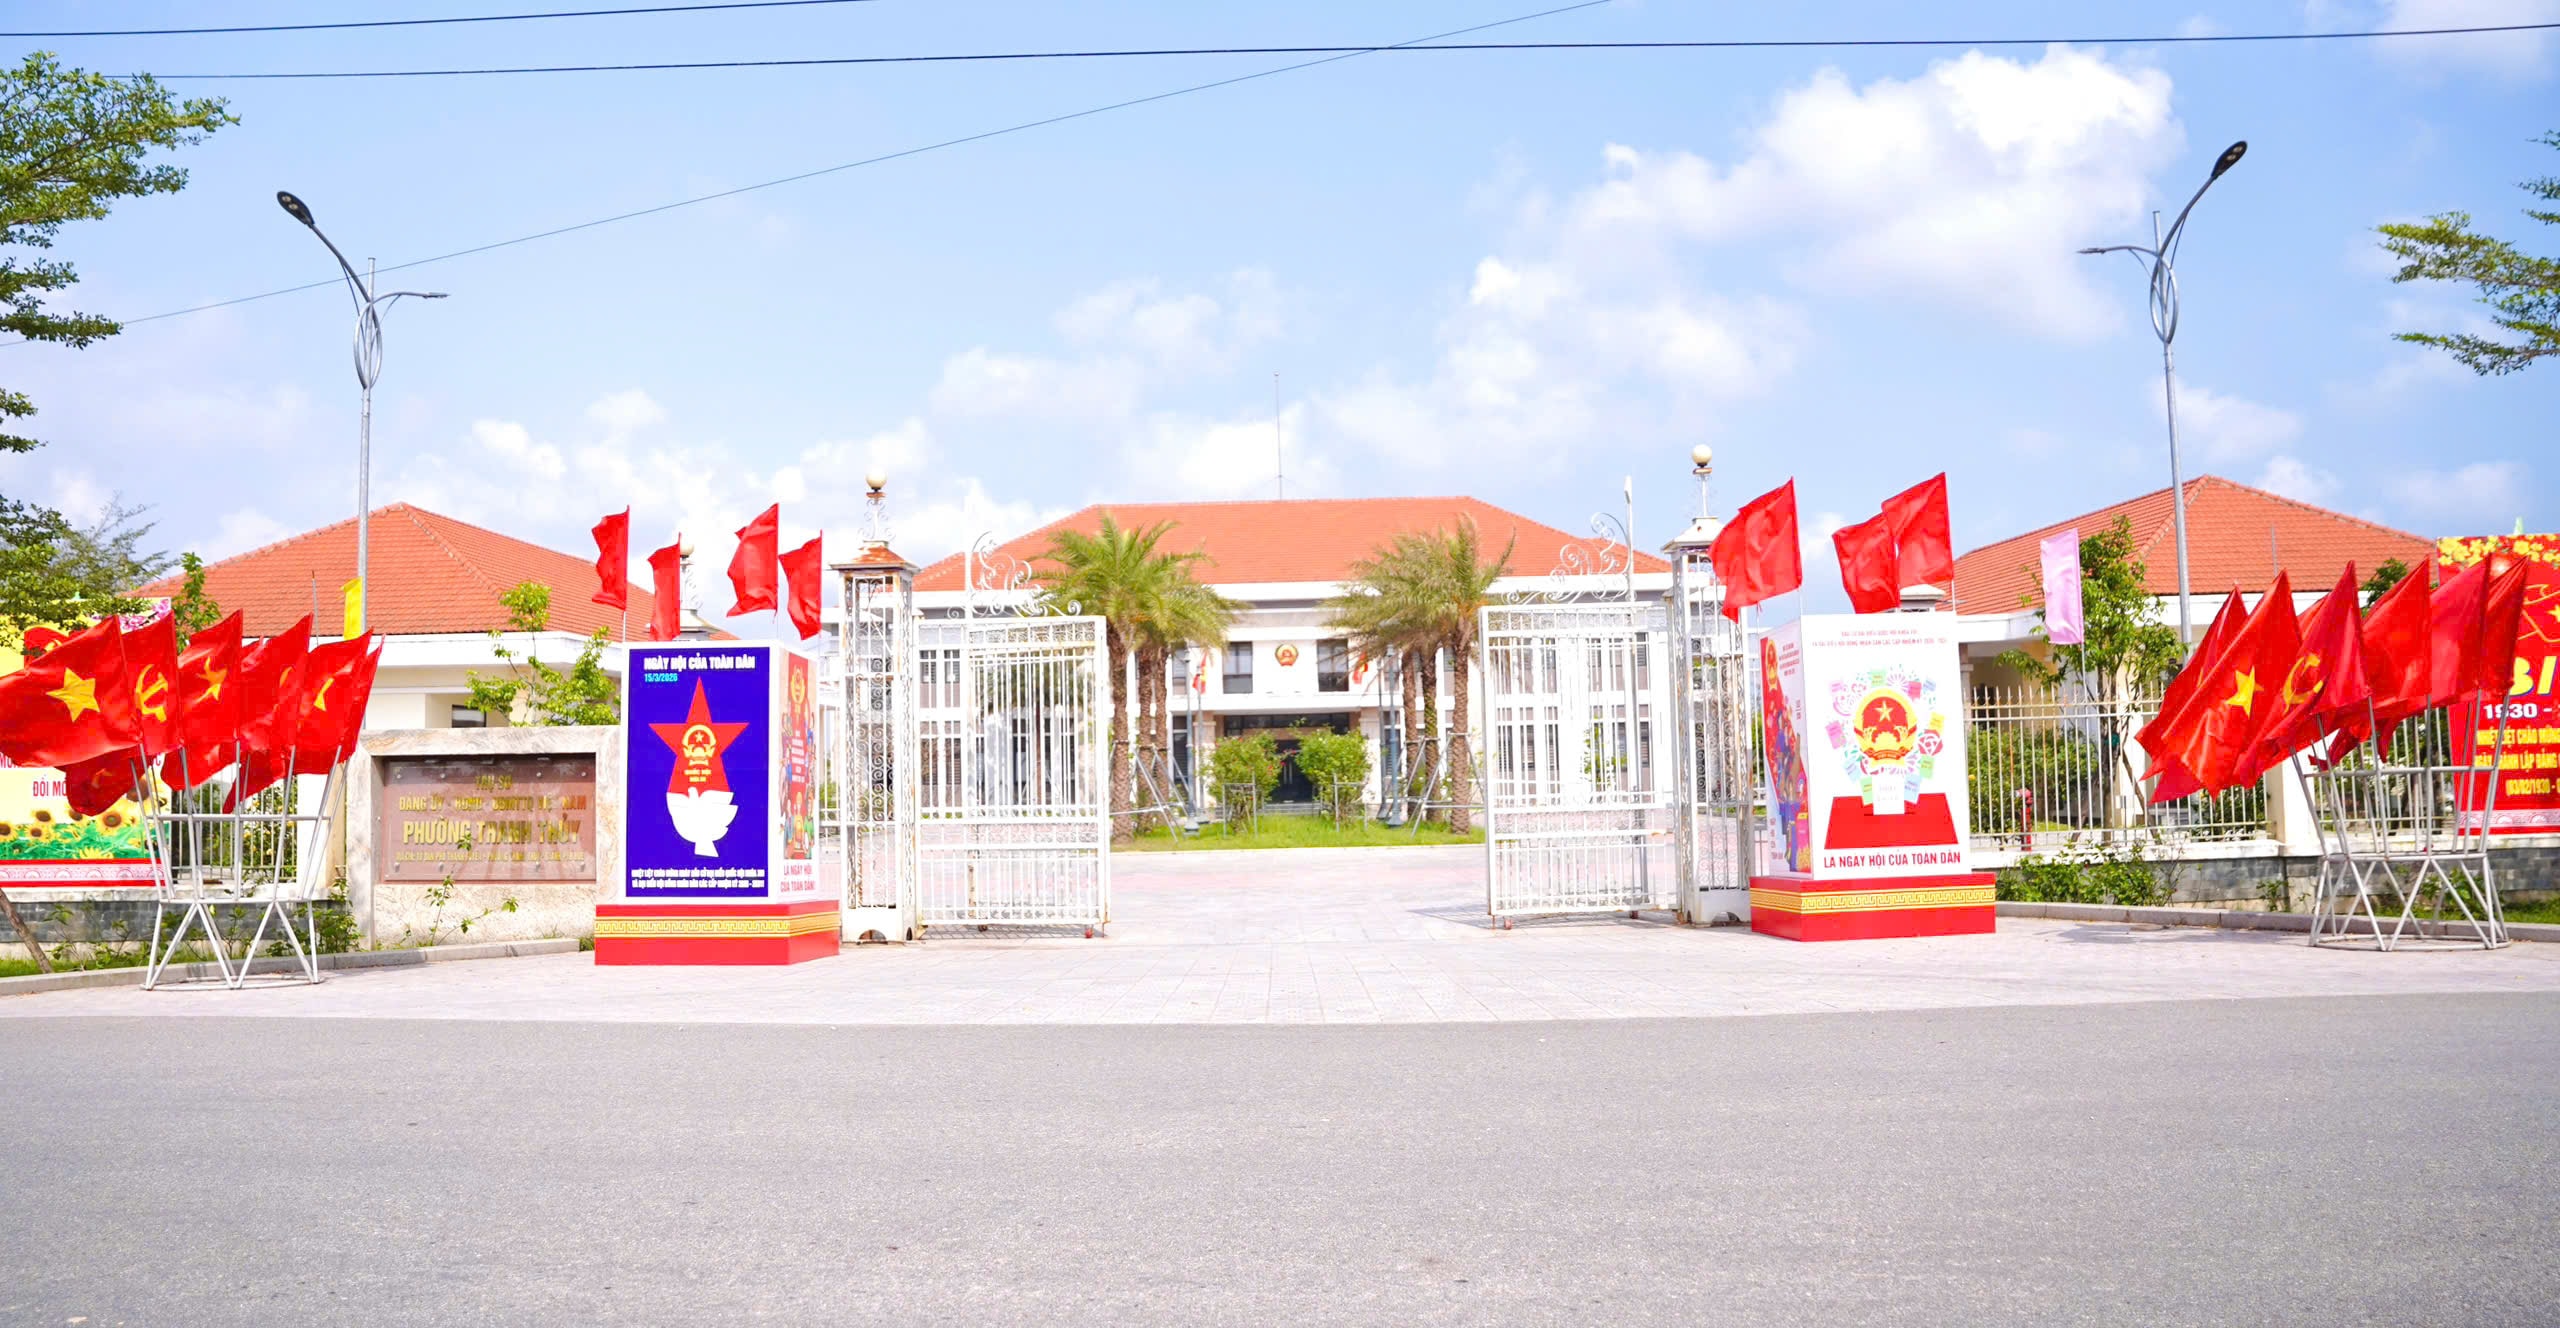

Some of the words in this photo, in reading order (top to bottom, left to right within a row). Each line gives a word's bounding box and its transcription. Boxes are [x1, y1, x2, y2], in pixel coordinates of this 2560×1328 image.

[644, 655, 669, 670] NGÀY
[670, 655, 687, 672] HỘI
[688, 652, 708, 670] CỦA
[709, 654, 734, 670] TOÀN
[735, 654, 756, 669] DÂN
[644, 673, 678, 682] 15/3/2026
